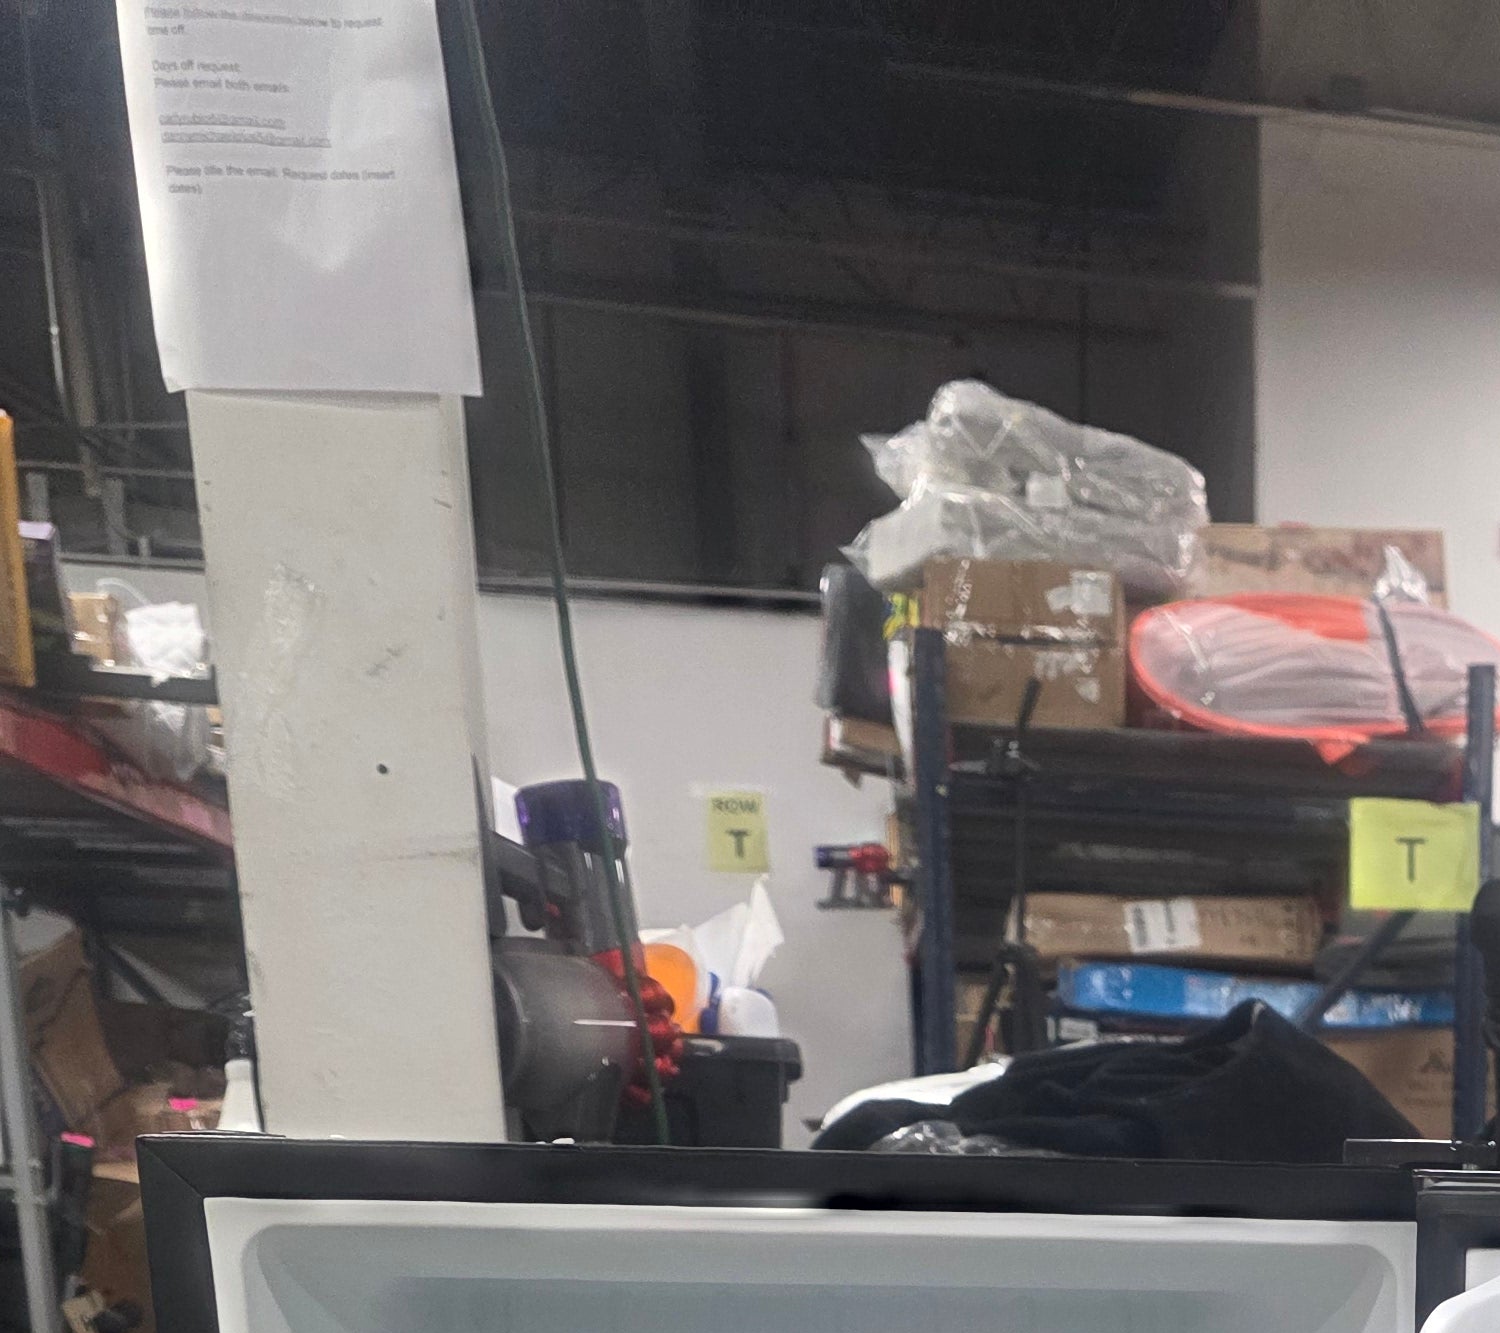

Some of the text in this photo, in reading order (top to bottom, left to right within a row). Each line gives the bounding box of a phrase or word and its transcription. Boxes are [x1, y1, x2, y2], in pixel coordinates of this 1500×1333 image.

[152, 60, 179, 73] Days
[180, 60, 194, 71] off
[154, 78, 189, 89] Please
[192, 80, 222, 89] email
[166, 165, 201, 177] Please
[226, 163, 244, 176] the
[711, 798, 759, 814] ROW
[726, 829, 751, 859] T
[1396, 837, 1427, 883] T
